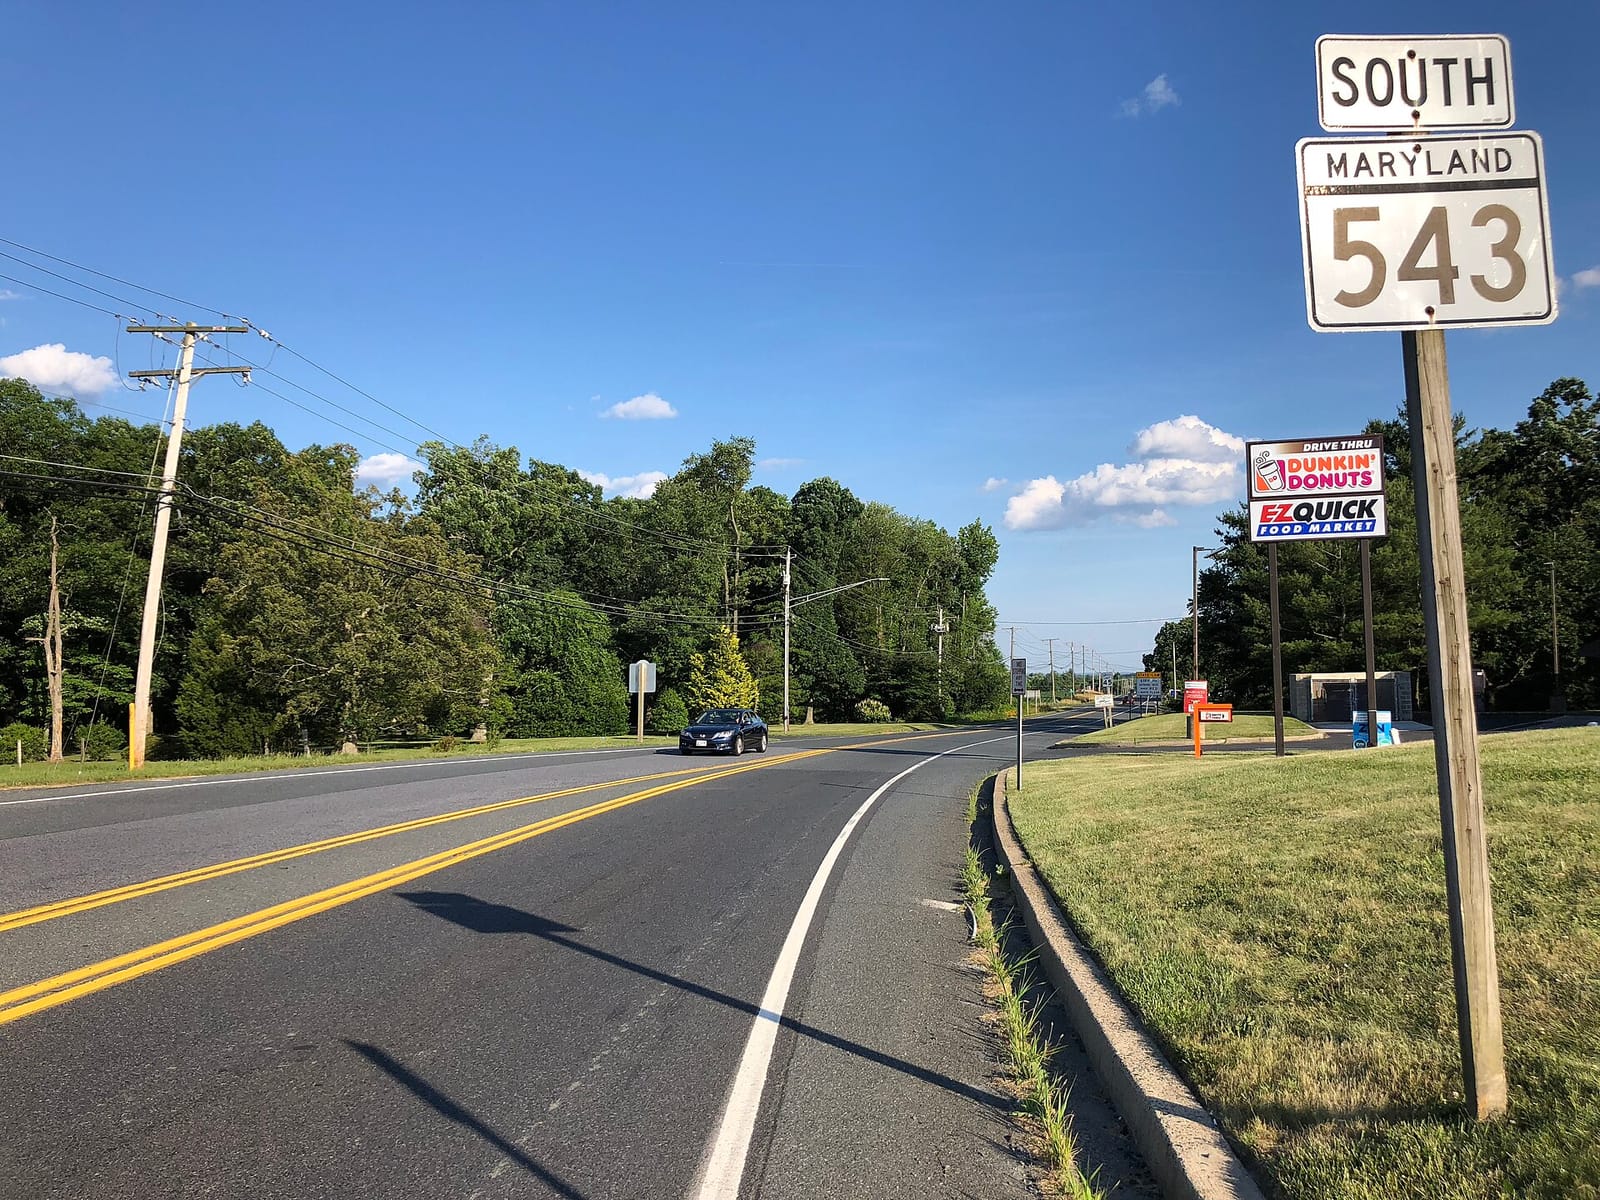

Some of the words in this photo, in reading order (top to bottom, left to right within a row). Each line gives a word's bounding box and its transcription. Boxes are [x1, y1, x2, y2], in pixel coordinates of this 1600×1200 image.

[1331, 56, 1496, 107] SOUTH
[1326, 148, 1513, 178] MARYLAND
[1332, 203, 1527, 309] 543
[1303, 441, 1341, 452] DRIVE
[1341, 439, 1373, 450] THRU
[1287, 454, 1376, 473] DUNKIN'
[1288, 471, 1373, 489] DONUTS
[1260, 525, 1303, 535] FOOD
[1308, 521, 1374, 533] MARKET
